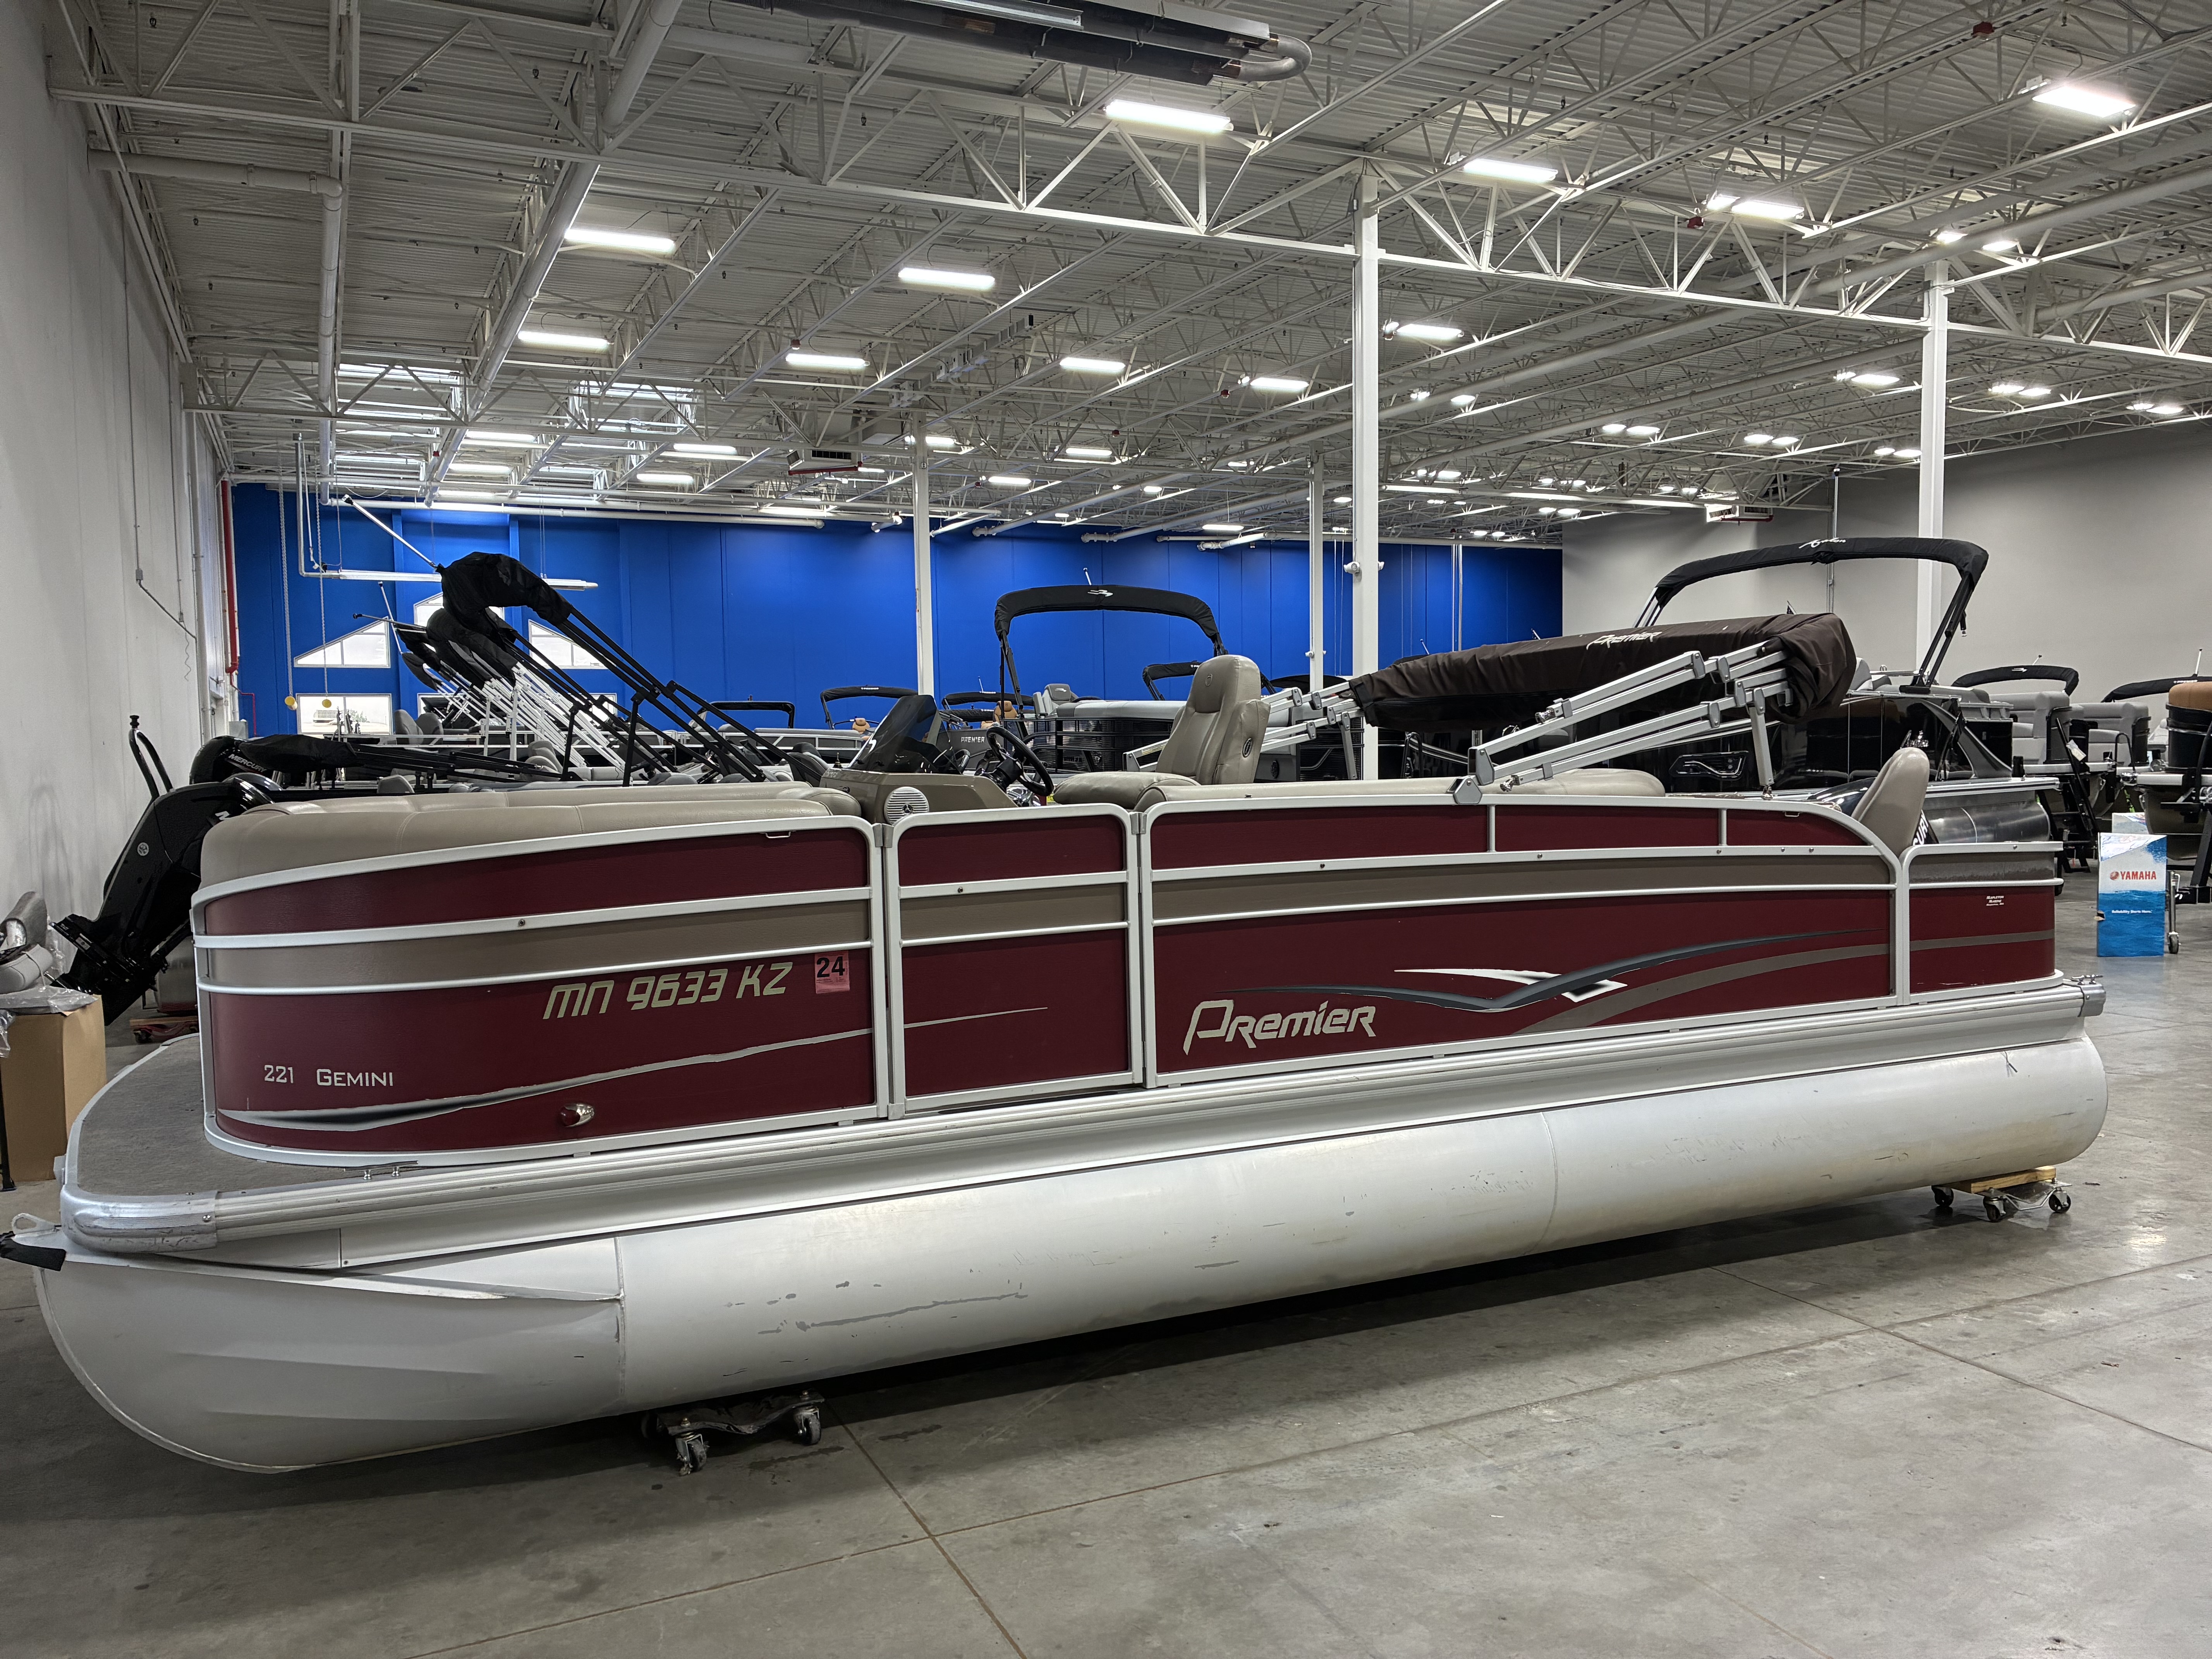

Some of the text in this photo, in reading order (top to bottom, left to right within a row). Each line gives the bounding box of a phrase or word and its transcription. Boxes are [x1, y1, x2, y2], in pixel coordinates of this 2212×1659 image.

[228, 754, 267, 772] MERCURY
[2120, 871, 2156, 880] YAMAHA
[817, 956, 845, 977] 24
[626, 969, 728, 1010] 9633
[736, 962, 793, 999] KZ
[264, 1065, 393, 1086] 221 GEMINI
